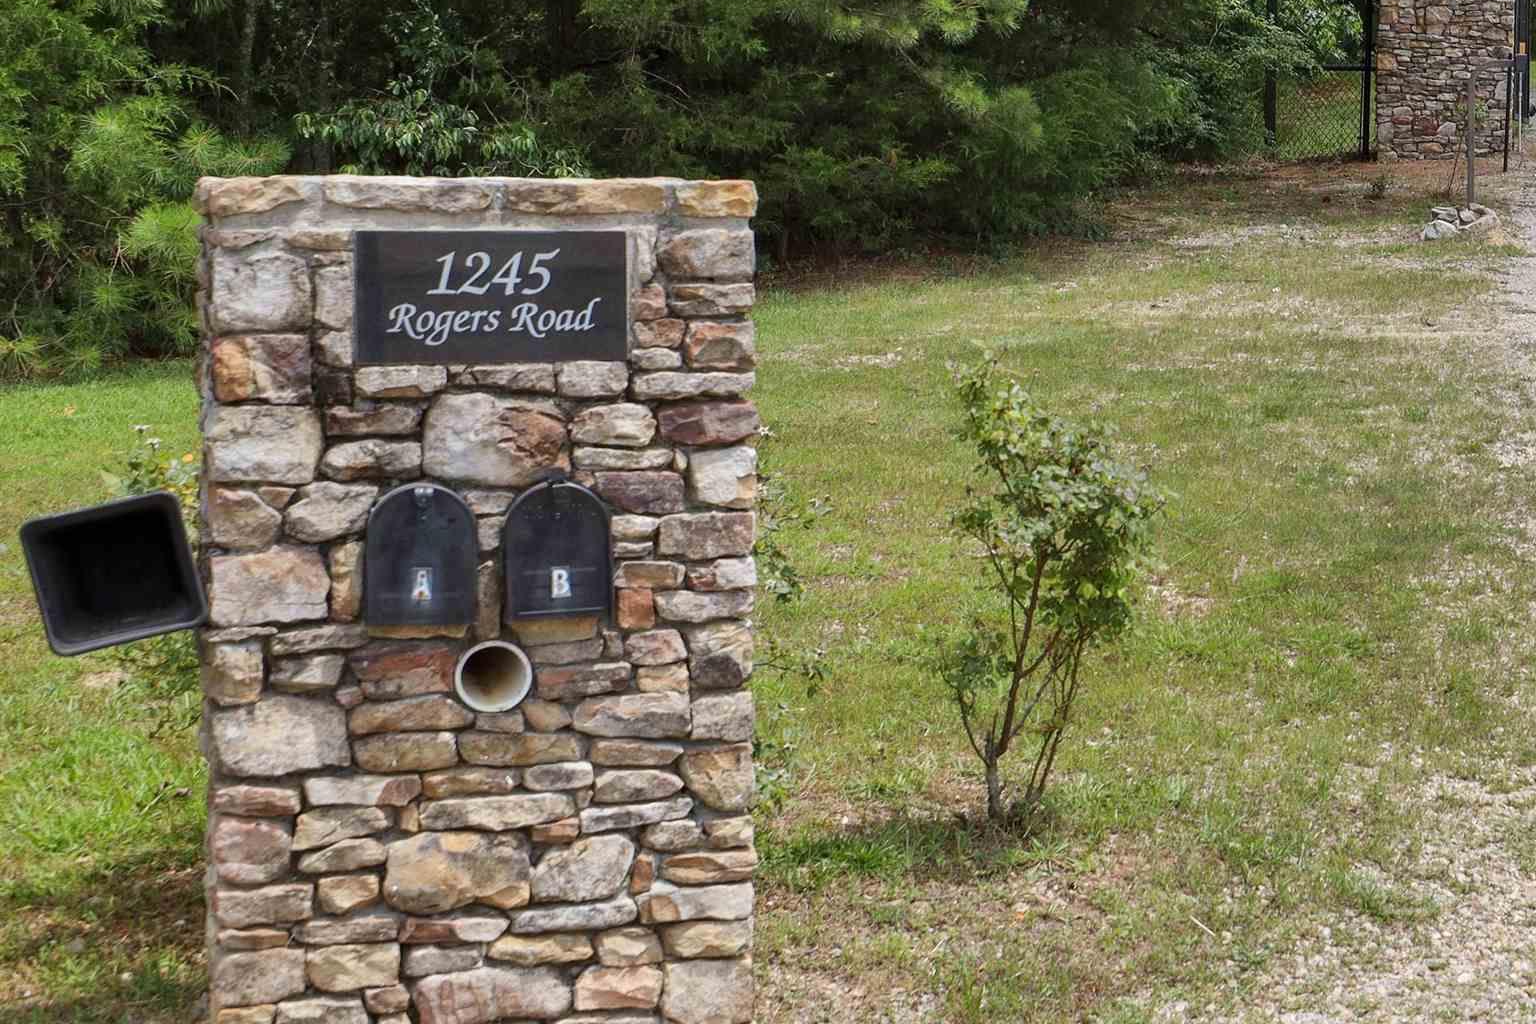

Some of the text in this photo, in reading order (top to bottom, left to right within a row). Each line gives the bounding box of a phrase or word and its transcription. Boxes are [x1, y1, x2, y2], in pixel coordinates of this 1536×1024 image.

[426, 247, 561, 296] 1245
[386, 297, 602, 347] Rogers Road
[411, 569, 433, 601] A
[551, 568, 573, 598] B
